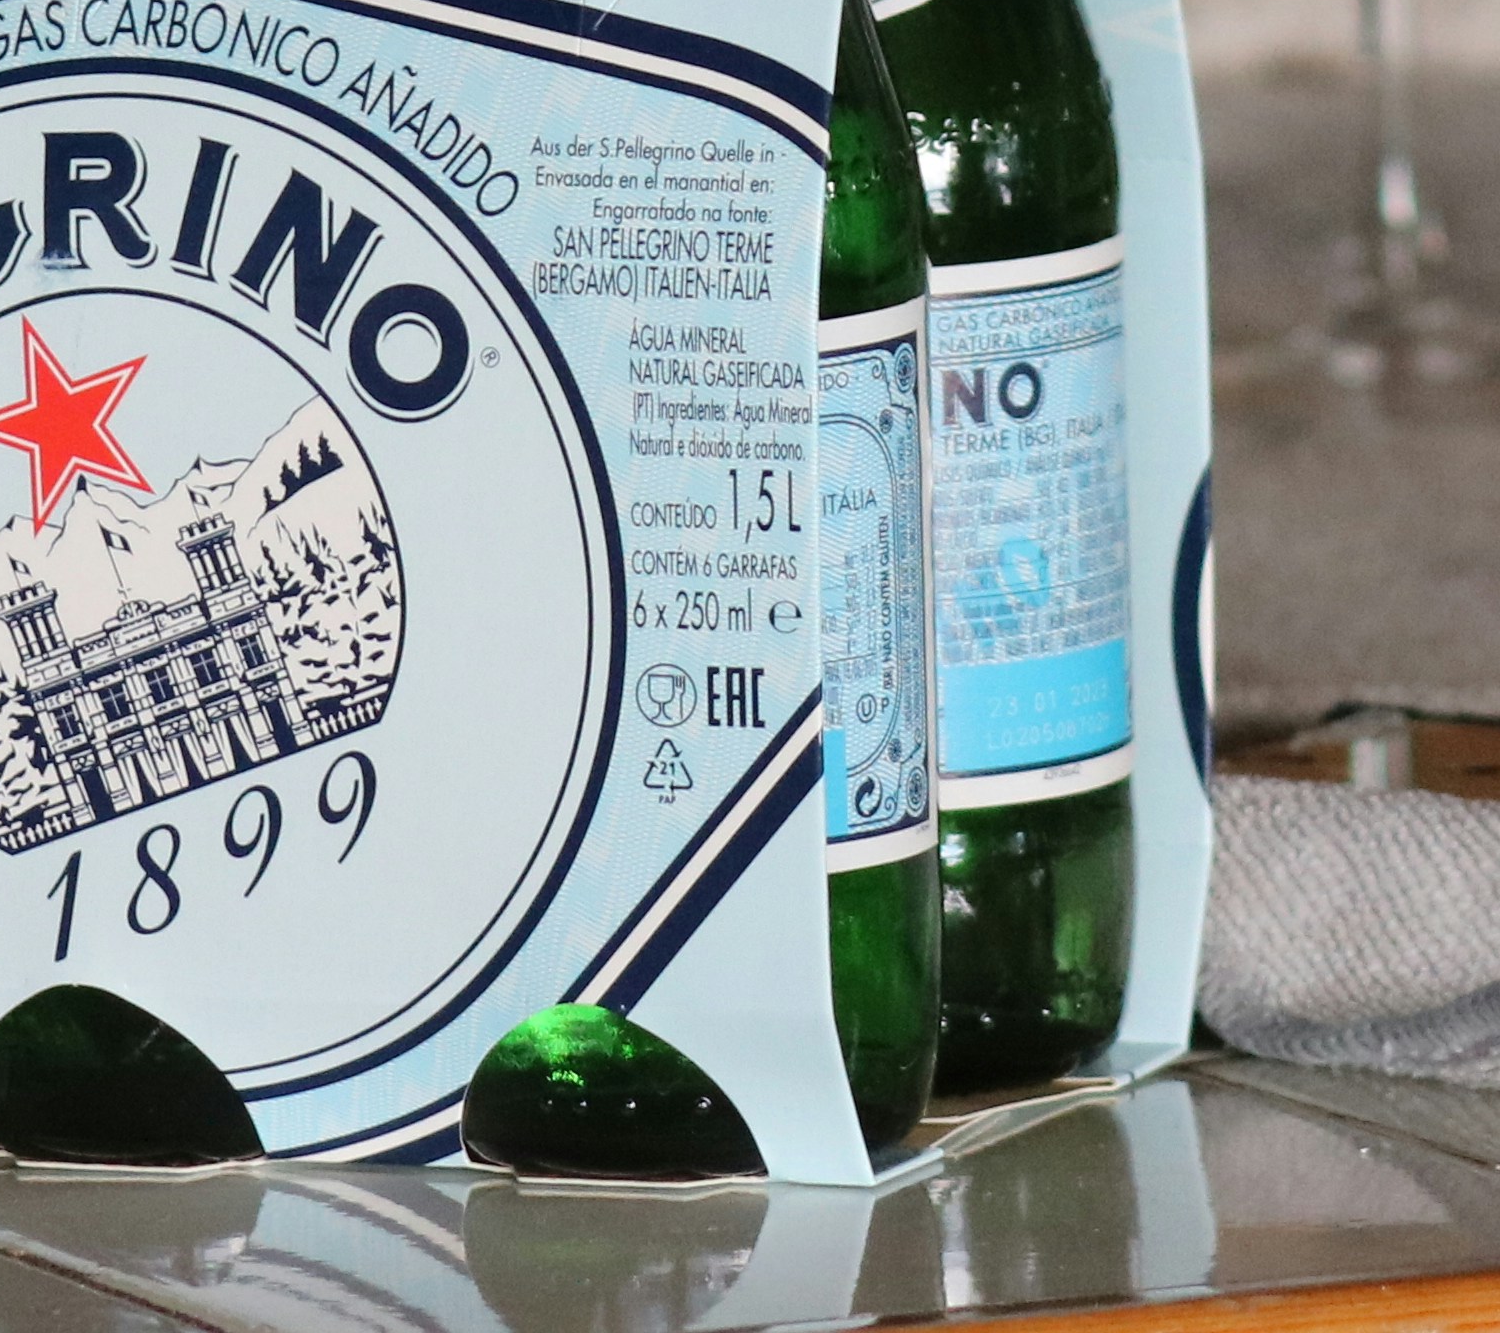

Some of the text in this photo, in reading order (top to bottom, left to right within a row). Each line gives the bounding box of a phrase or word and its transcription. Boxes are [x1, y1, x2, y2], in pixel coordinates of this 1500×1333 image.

[338, 60, 519, 218] AÑADIDO
[531, 136, 561, 156] Aus
[567, 135, 593, 158] der
[600, 136, 695, 166] S.Pellegrino
[701, 140, 754, 163] Quelle
[760, 143, 774, 163] in
[535, 164, 774, 194] Envasada en el manantial en:
[593, 197, 772, 225] Engarrafado na fonte:
[553, 226, 774, 264] SAN PELLEGRINO TERME
[532, 261, 772, 303] (BERGAMO) ITALIEN-ITALIA
[629, 317, 747, 354] ÁGUA MINERAL
[938, 331, 1021, 353] NATURAL
[630, 358, 805, 389] NATURAL GASEIFICADA
[633, 392, 654, 424] (PT)
[658, 391, 730, 428] Ingredientes:
[769, 396, 813, 424] Mineral
[941, 361, 1043, 427] NO
[630, 429, 806, 461] Natural e dióxido de carbono.
[942, 429, 1011, 454] TERME
[631, 469, 802, 544] CONTEÚDO 1,5 L
[631, 545, 797, 580] CONTÉM 6 GARRAFAS
[633, 589, 647, 628] 6
[655, 603, 668, 629] x
[676, 591, 720, 631] 250
[728, 587, 752, 632] ml
[46, 750, 378, 963] 1899
